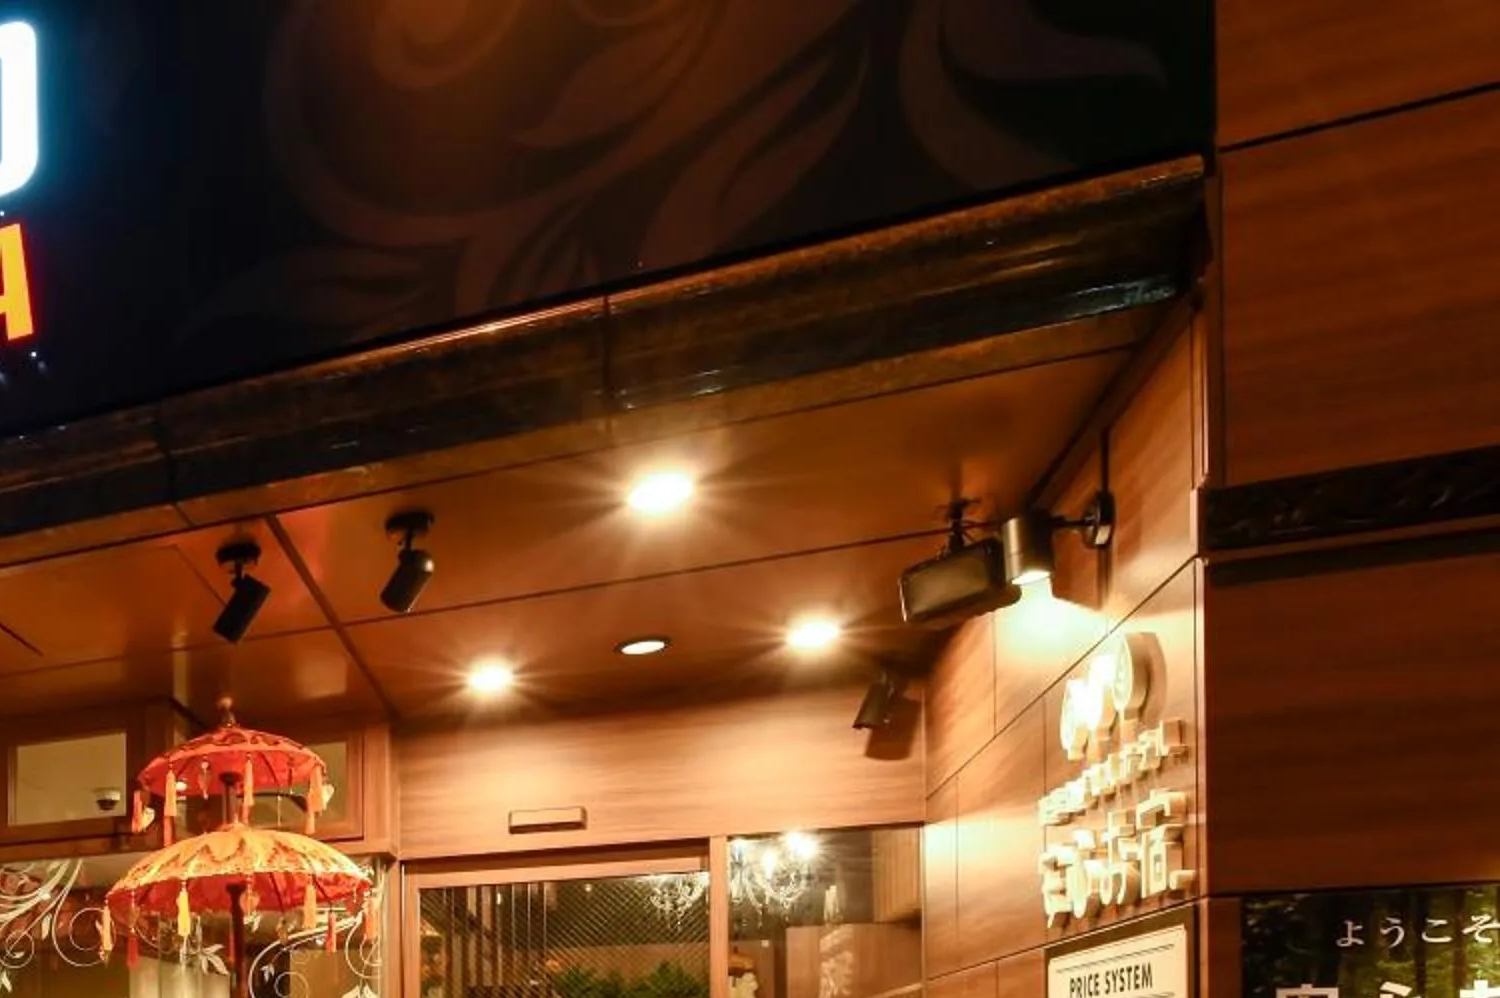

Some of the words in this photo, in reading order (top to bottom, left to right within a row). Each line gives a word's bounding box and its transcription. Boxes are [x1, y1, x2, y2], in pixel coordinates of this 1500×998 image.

[1335, 913, 1500, 949] ようこそ
[1104, 962, 1153, 995] SYSTEM
